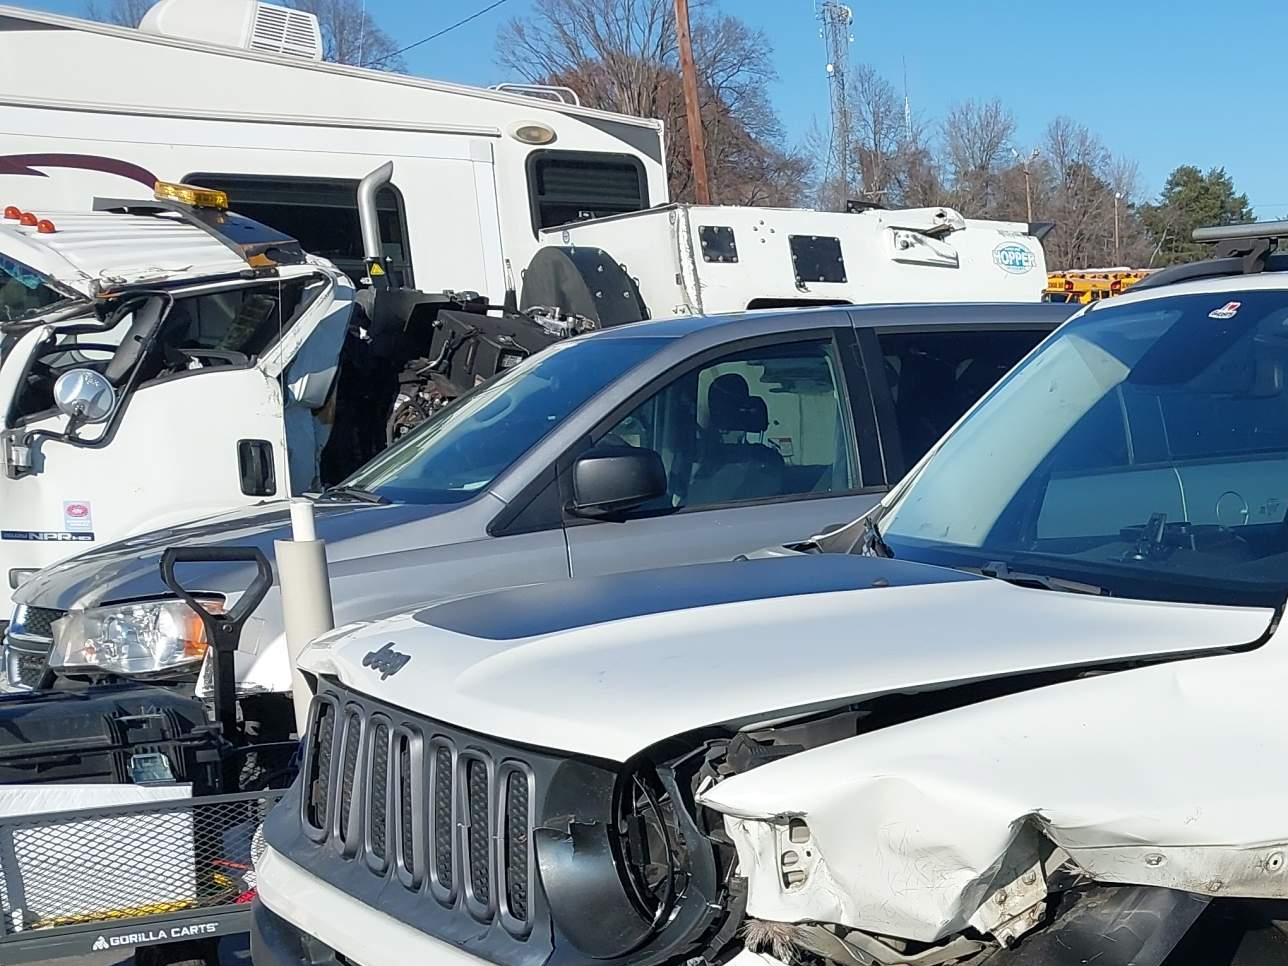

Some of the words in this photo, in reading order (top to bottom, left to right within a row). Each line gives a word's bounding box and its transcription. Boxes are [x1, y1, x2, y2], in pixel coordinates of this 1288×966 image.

[992, 249, 1037, 267] HOPPER
[29, 532, 72, 541] NPR
[110, 930, 167, 946] GORILLA
[171, 923, 217, 938] CARTS
